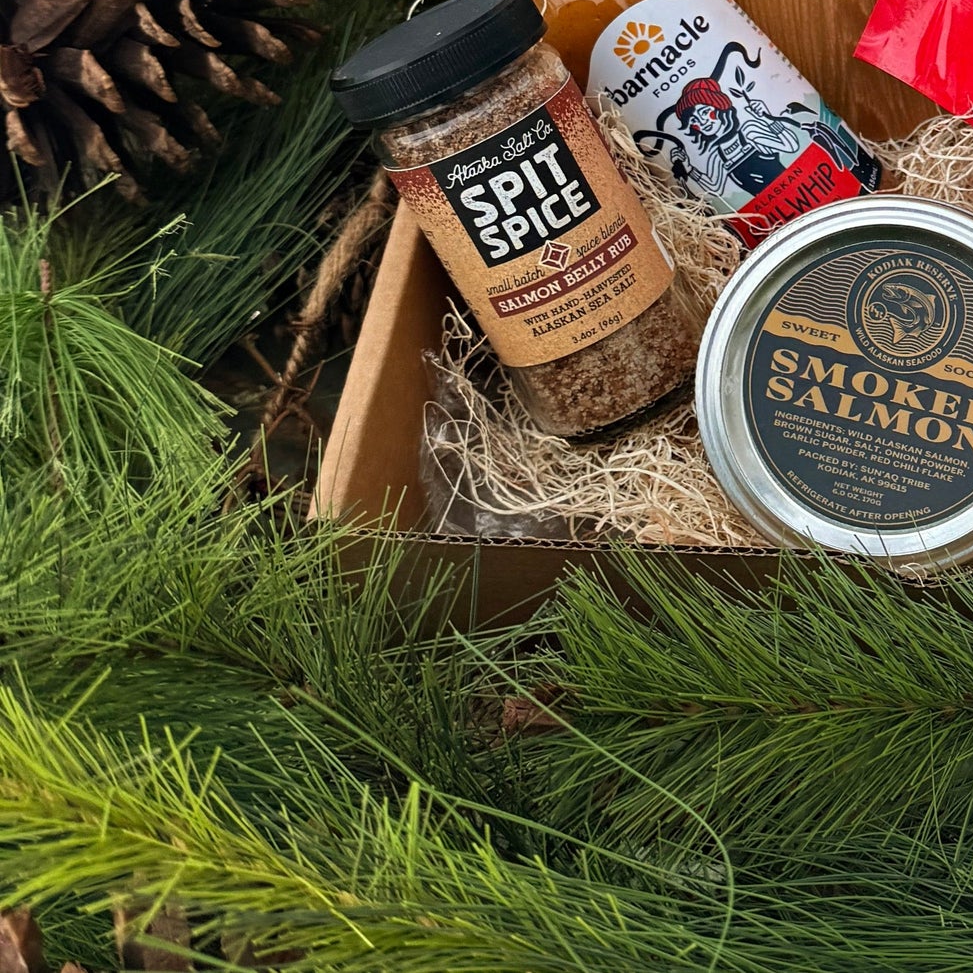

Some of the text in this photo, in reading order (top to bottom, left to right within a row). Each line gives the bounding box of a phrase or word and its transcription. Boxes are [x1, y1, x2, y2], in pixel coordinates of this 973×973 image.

[604, 15, 710, 107] barnacle
[652, 58, 697, 99] FOODS
[445, 119, 554, 190] Alaska Salt Co.
[460, 142, 567, 228] SPIT
[753, 166, 803, 213] ALASKAN
[479, 179, 592, 260] SPICE
[486, 212, 626, 296] small batch spice blends
[498, 233, 632, 313] SALMON BELLY RUB
[523, 263, 632, 327] WITH HAND-HARVESTED
[866, 257, 959, 302] KODIAK RESERVE
[531, 273, 638, 337] ALASKAN SEA SALT
[781, 320, 841, 343] SWEET
[855, 326, 943, 367] WILD ALASKAN SEAFOOD
[773, 419, 813, 435] BROWN
[884, 448, 919, 464] ONION
[774, 409, 846, 435] INGREDIENTS:
[847, 428, 873, 442] WILD
[874, 437, 923, 456] ALASKAN
[782, 430, 820, 446] GARLIC
[870, 453, 891, 465] RED
[892, 460, 920, 473] CHILI
[921, 468, 954, 483] FLAKE
[798, 448, 839, 465] PACKED
[841, 460, 858, 471] BY:
[901, 476, 932, 491] TRIBE
[786, 469, 932, 521] REFRIGERATE AFTER OPENING
[832, 489, 846, 497] 6.0
[861, 494, 882, 507] 170G
[833, 481, 885, 499] NET WEIGHT
[860, 474, 875, 485] AK
[877, 478, 907, 493] 99615
